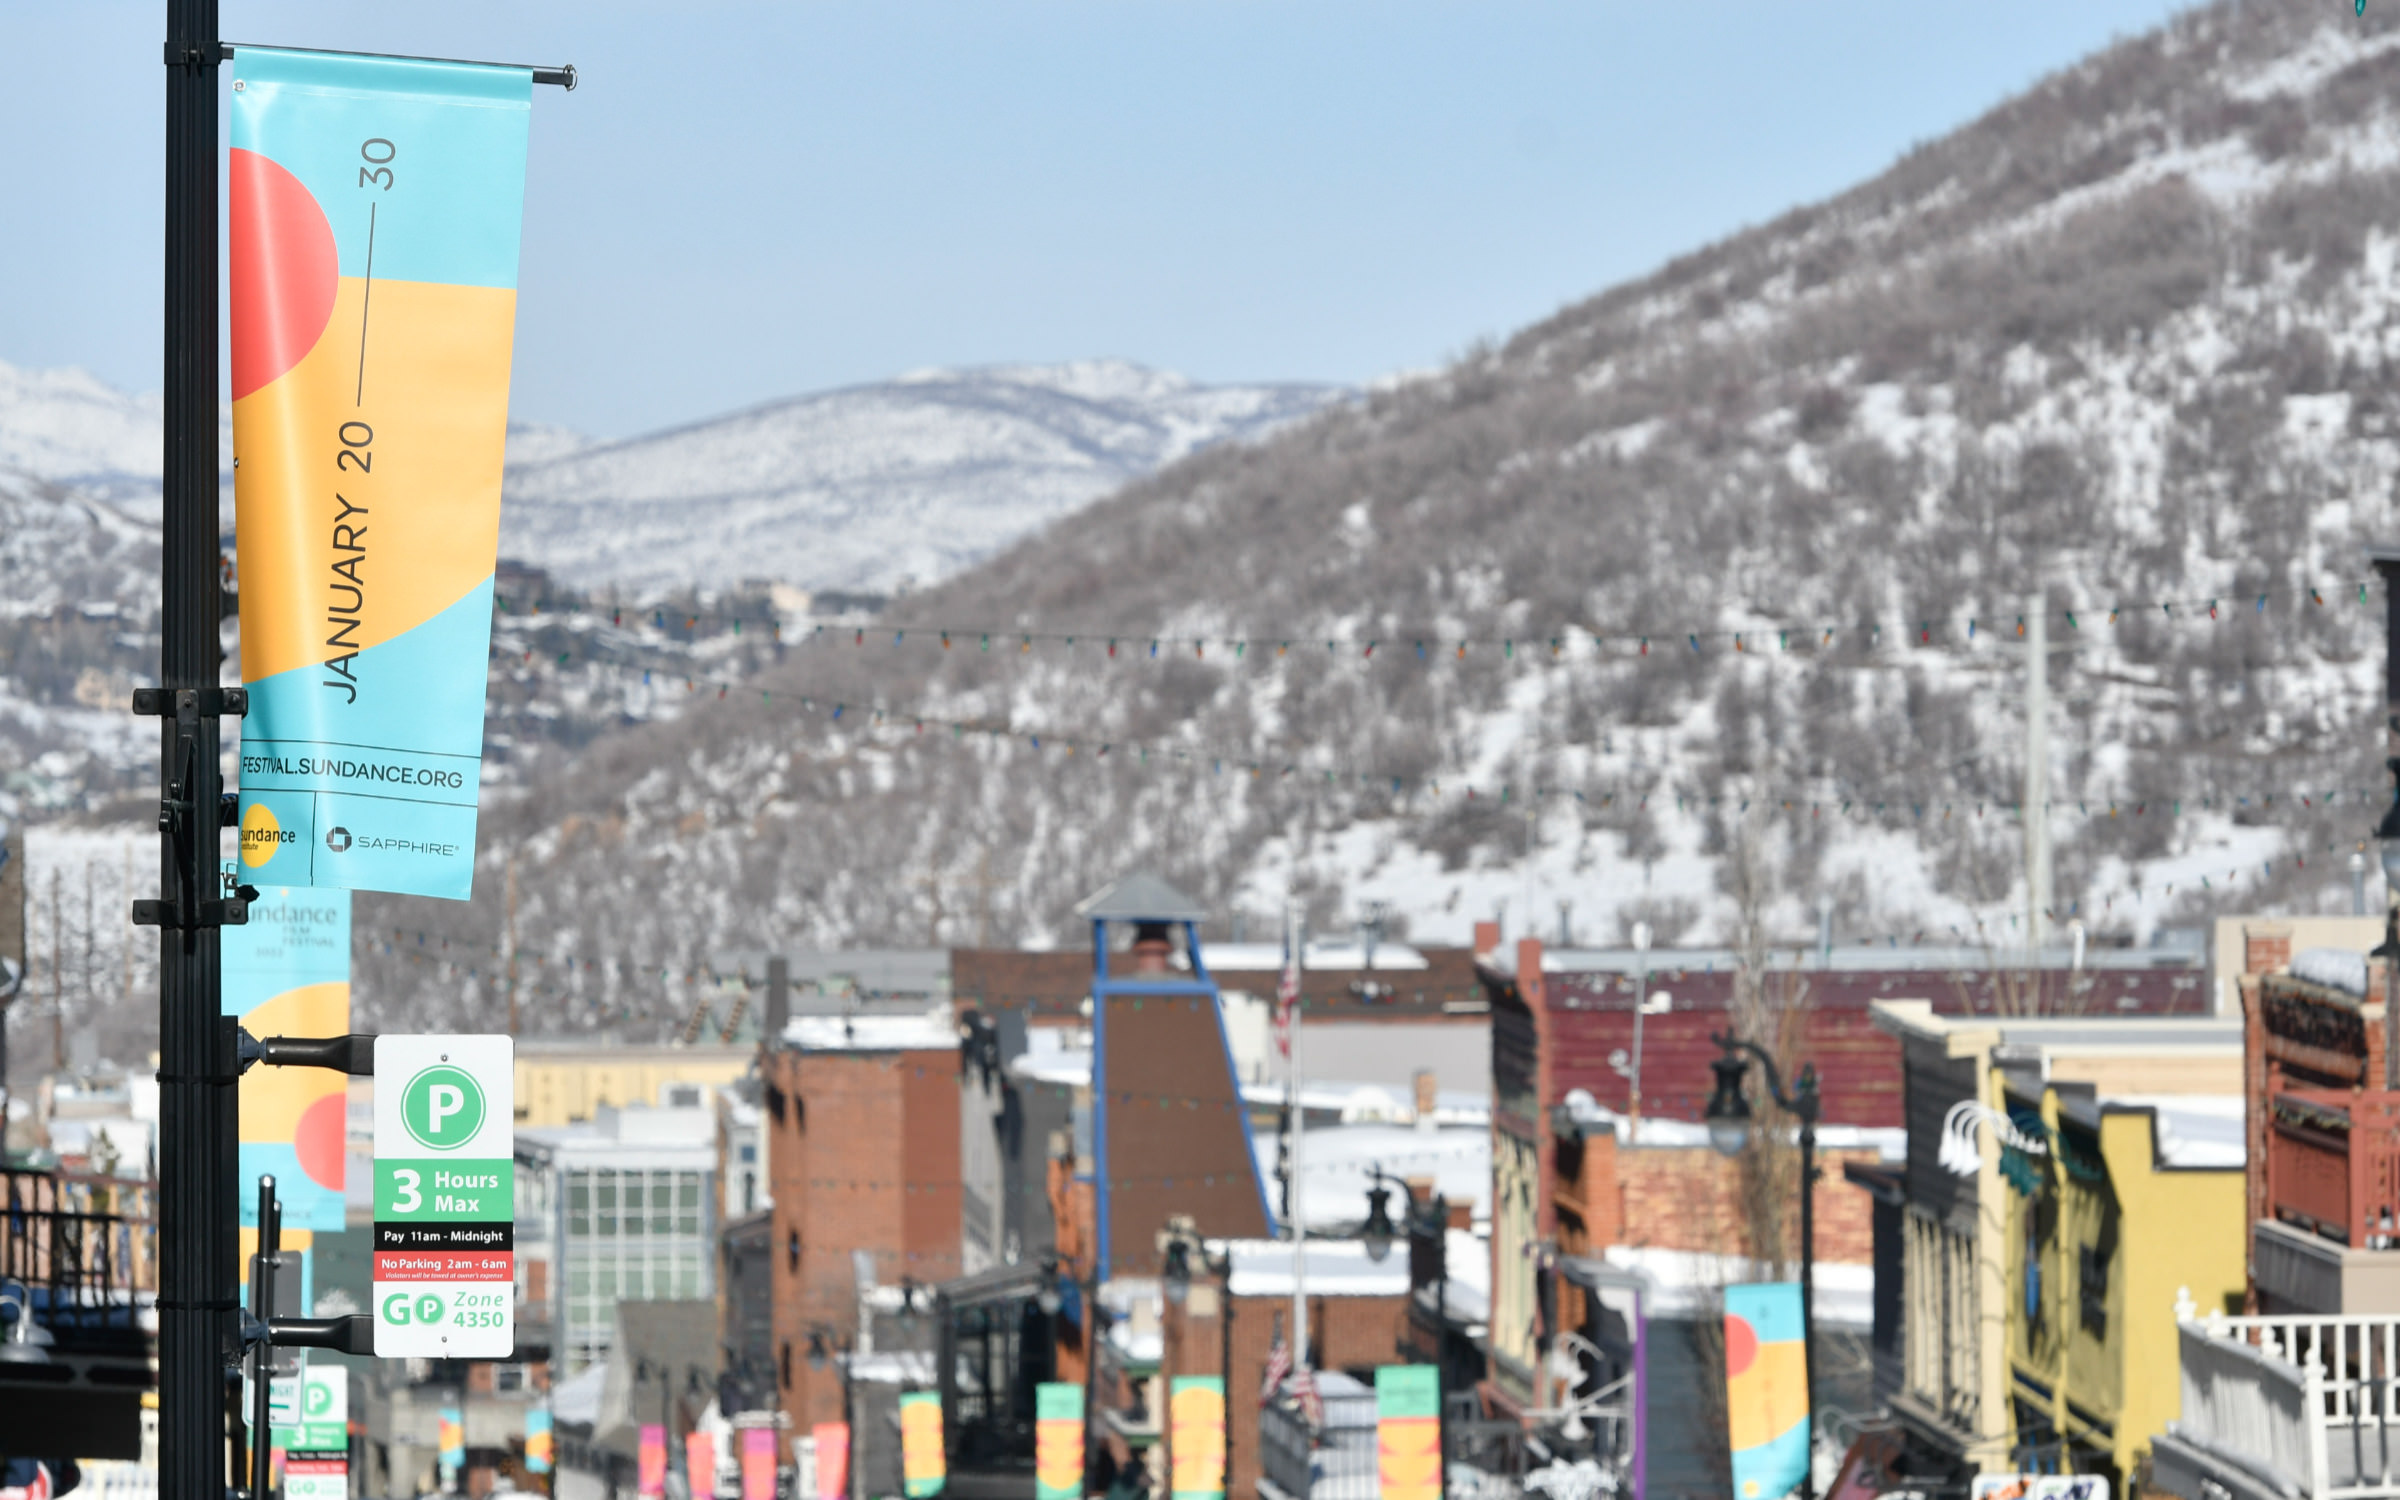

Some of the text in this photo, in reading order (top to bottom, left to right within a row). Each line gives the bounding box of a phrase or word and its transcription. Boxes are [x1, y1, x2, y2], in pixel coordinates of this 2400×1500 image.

[322, 138, 396, 705] JANUARY 20 30
[242, 756, 463, 789] FESTIVAL.SUNDANCE.ORG
[429, 1084, 465, 1133] P
[434, 1171, 499, 1189] Hours
[391, 1168, 422, 1213] 3
[434, 1195, 480, 1212] Max
[384, 1231, 405, 1243] Pay
[410, 1231, 441, 1241] 11am
[450, 1231, 504, 1243] Midnight
[381, 1259, 398, 1269] No
[399, 1258, 442, 1271] Parking
[454, 1292, 504, 1307] Zone
[453, 1312, 504, 1328] 4350
